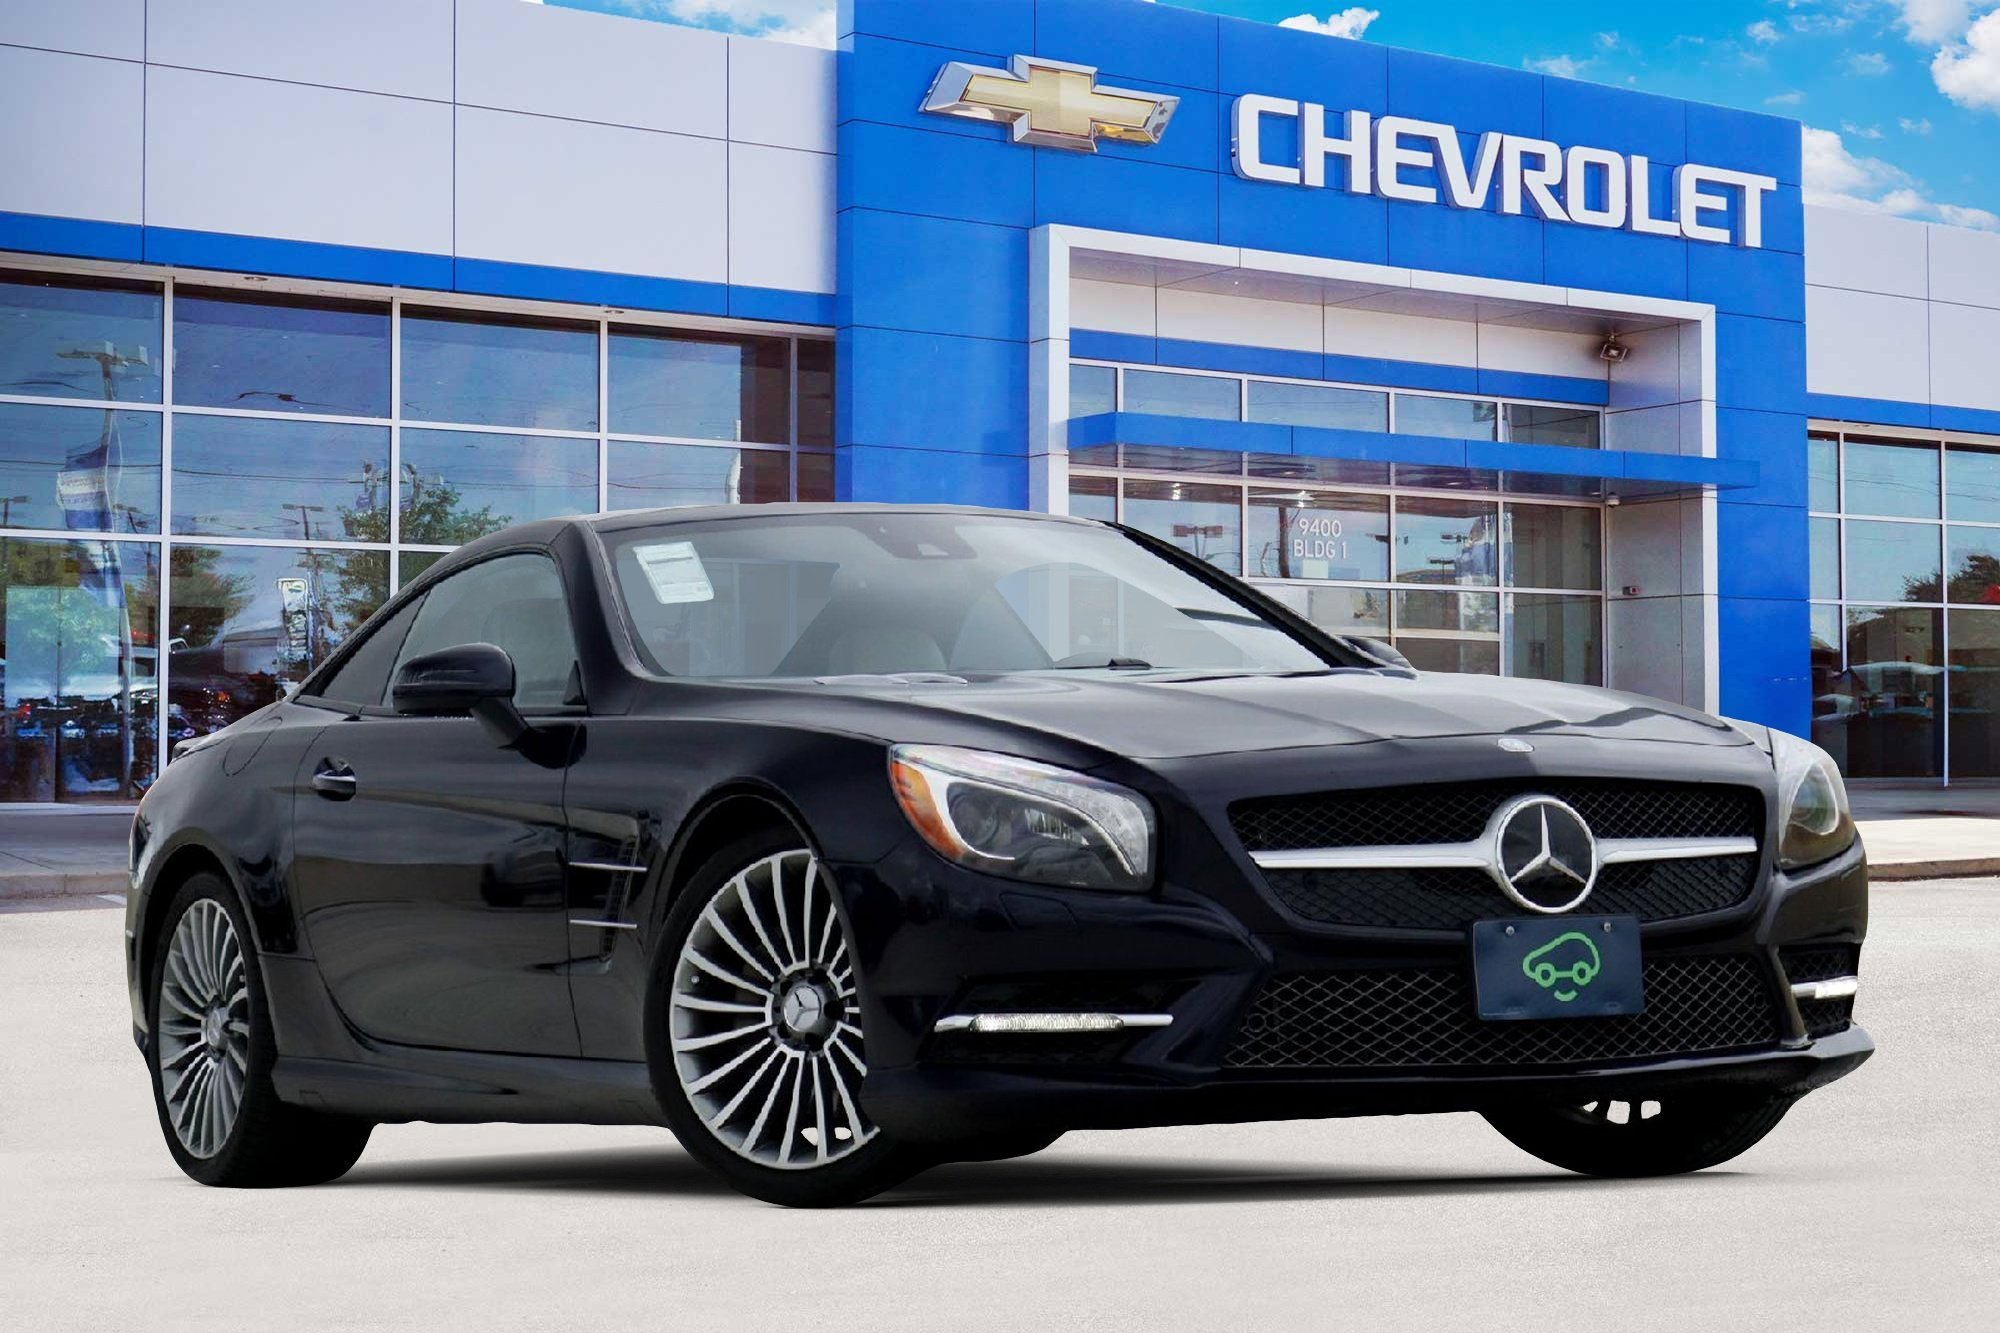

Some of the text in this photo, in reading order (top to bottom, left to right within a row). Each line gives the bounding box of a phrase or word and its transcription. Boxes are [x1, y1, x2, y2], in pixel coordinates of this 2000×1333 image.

[1232, 93, 1777, 248] CHEVROLET
[1298, 518, 1342, 538] 9400
[1293, 539, 1347, 559] BLDG 1
